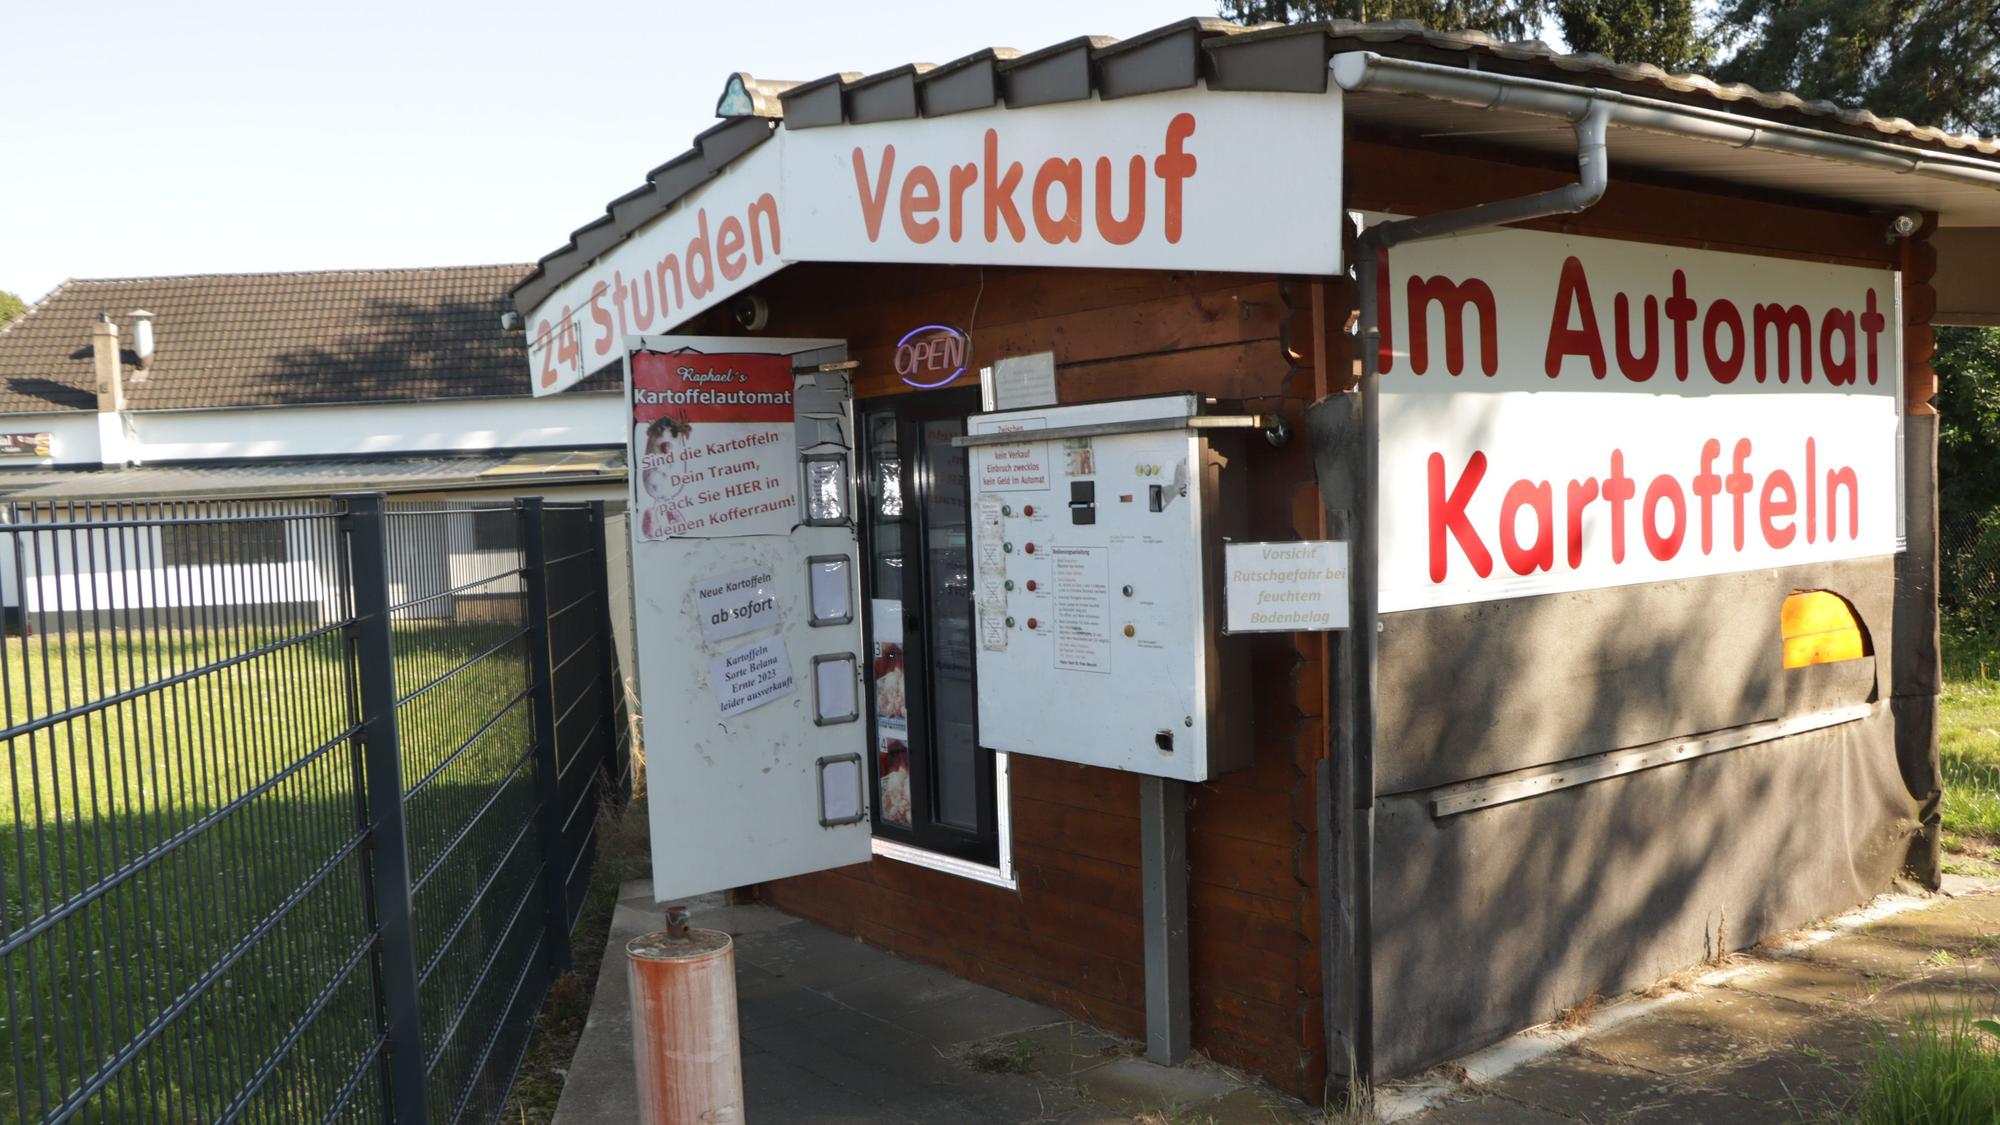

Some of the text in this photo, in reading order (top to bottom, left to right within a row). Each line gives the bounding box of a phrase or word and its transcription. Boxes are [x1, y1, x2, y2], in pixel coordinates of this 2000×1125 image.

[852, 112, 1197, 246] Verkauf
[536, 193, 781, 389] 24 Stunden
[1545, 255, 1885, 386] Automat
[895, 336, 965, 375] OPEN
[634, 388, 792, 405] Kartoffelautomat
[641, 431, 779, 471] Sind die Kartoffeln
[1008, 448, 1031, 459] Verkauf
[670, 459, 760, 487] Dein Traum,
[987, 462, 1040, 473] Einbruch zwecklos
[659, 477, 780, 516] pack Sie HIER in
[1427, 436, 1858, 584] Kartoffeln
[654, 495, 796, 538] deinen Kofferraum!
[1262, 547, 1317, 560] Vorsicht
[700, 573, 771, 600] Neue Kartoffeln
[1232, 567, 1346, 584] Rutschgefahr bei
[711, 598, 773, 625] ab sofort
[1256, 590, 1321, 606] feuchtem
[1250, 610, 1330, 624] Bodenbelag
[726, 645, 768, 668] Kartoffeln
[725, 667, 748, 682] Sorte
[732, 669, 777, 694] Ernte 2023
[720, 676, 794, 712] leider ausverkauft
